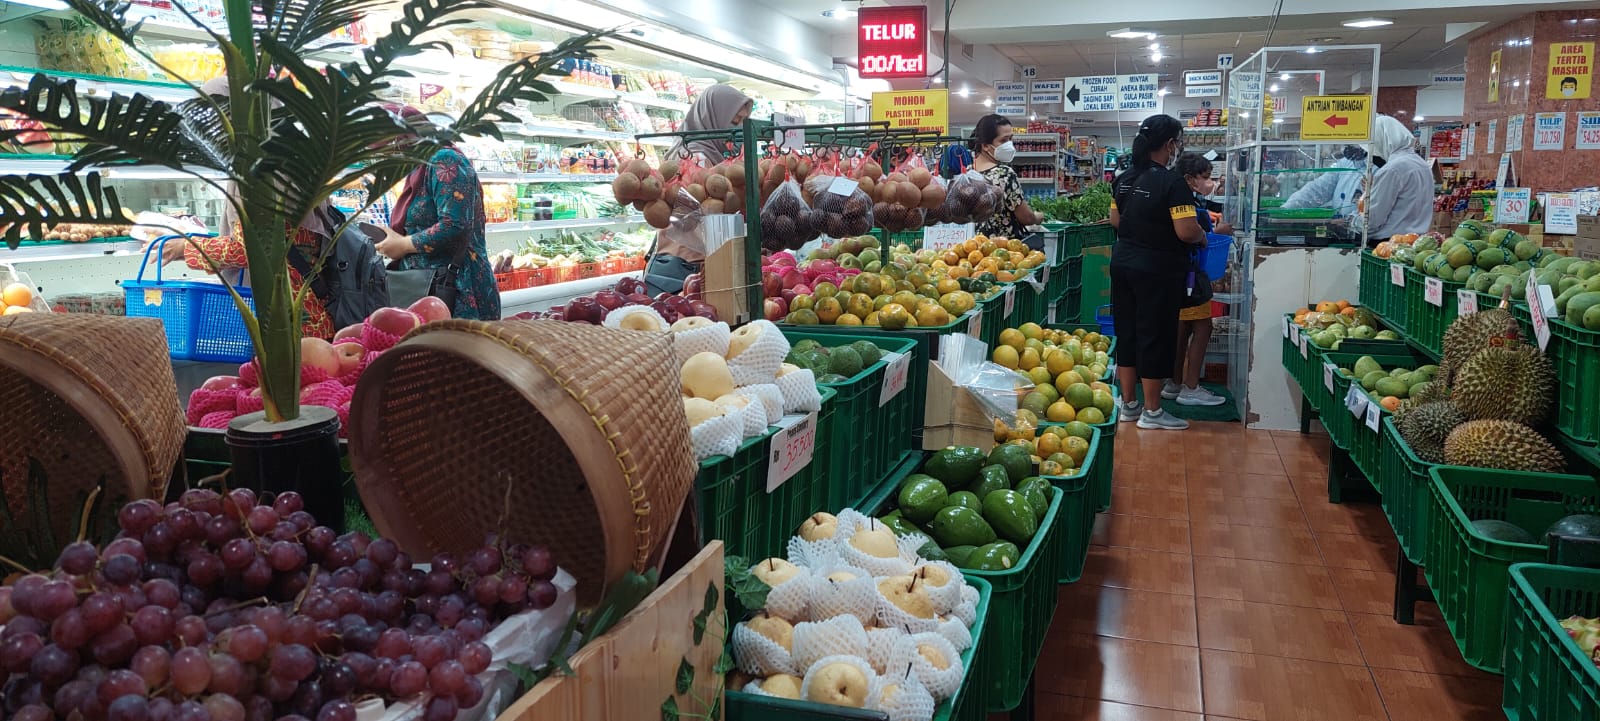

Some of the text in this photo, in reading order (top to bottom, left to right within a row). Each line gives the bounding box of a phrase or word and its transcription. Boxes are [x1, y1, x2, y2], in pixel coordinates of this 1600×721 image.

[862, 23, 916, 40] TELUR
[1561, 45, 1583, 54] AREA
[1219, 57, 1232, 65] 17
[1556, 56, 1586, 64] TERTIB
[1024, 68, 1035, 76] 18
[1552, 66, 1588, 75] MASKER
[894, 96, 925, 105] MOHON
[1307, 100, 1363, 111] ANTRIAN TIMBANGAN
[886, 109, 934, 118] PLASTIK TELUR
[1540, 131, 1560, 144] 10.750
[1583, 131, 1600, 144] 54.25
[1506, 200, 1522, 212] 30
